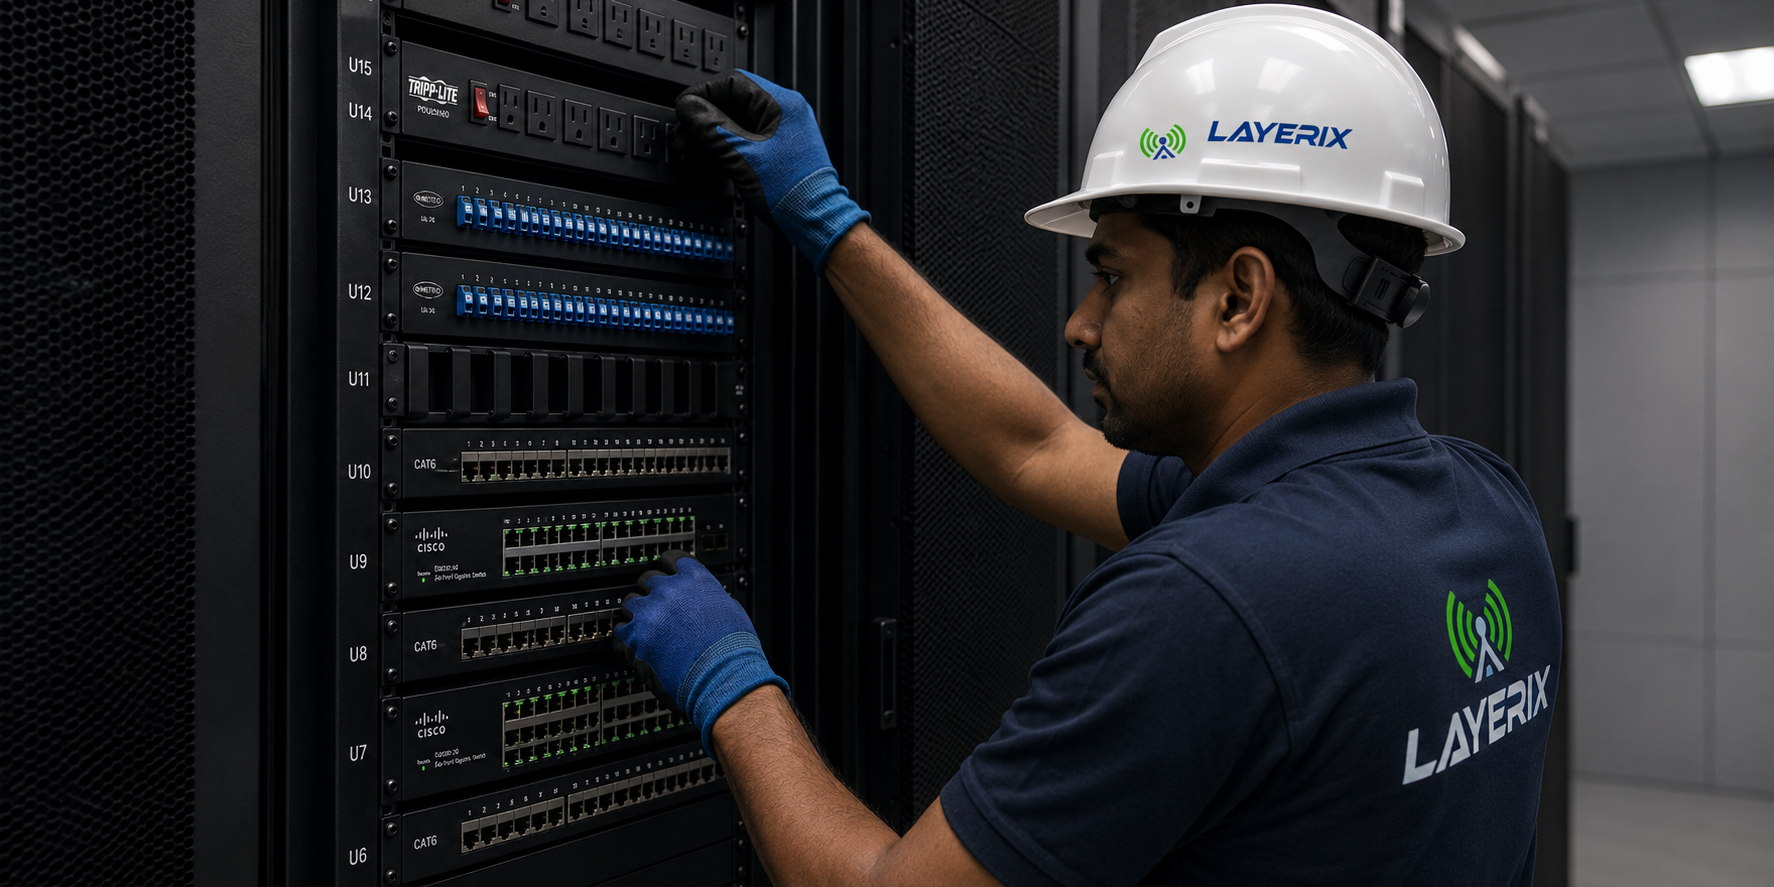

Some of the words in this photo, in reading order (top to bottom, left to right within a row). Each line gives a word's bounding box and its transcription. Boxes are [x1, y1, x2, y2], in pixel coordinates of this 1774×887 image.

[348, 56, 372, 76] U15
[348, 101, 373, 121] U14
[1208, 120, 1353, 150] LAYERIX
[348, 186, 372, 205] U13
[348, 283, 372, 301] U12
[348, 371, 370, 387] U11
[348, 463, 371, 480] U10
[414, 458, 437, 470] CAT6
[417, 542, 446, 553] CISCO
[349, 553, 368, 570] U9
[349, 645, 368, 663] U8
[414, 639, 437, 653] CAT6
[417, 725, 446, 739] CISCO
[1402, 664, 1552, 786] LAYERIX
[349, 743, 367, 762] U7
[413, 834, 438, 850] CAT6
[349, 847, 367, 866] U6
